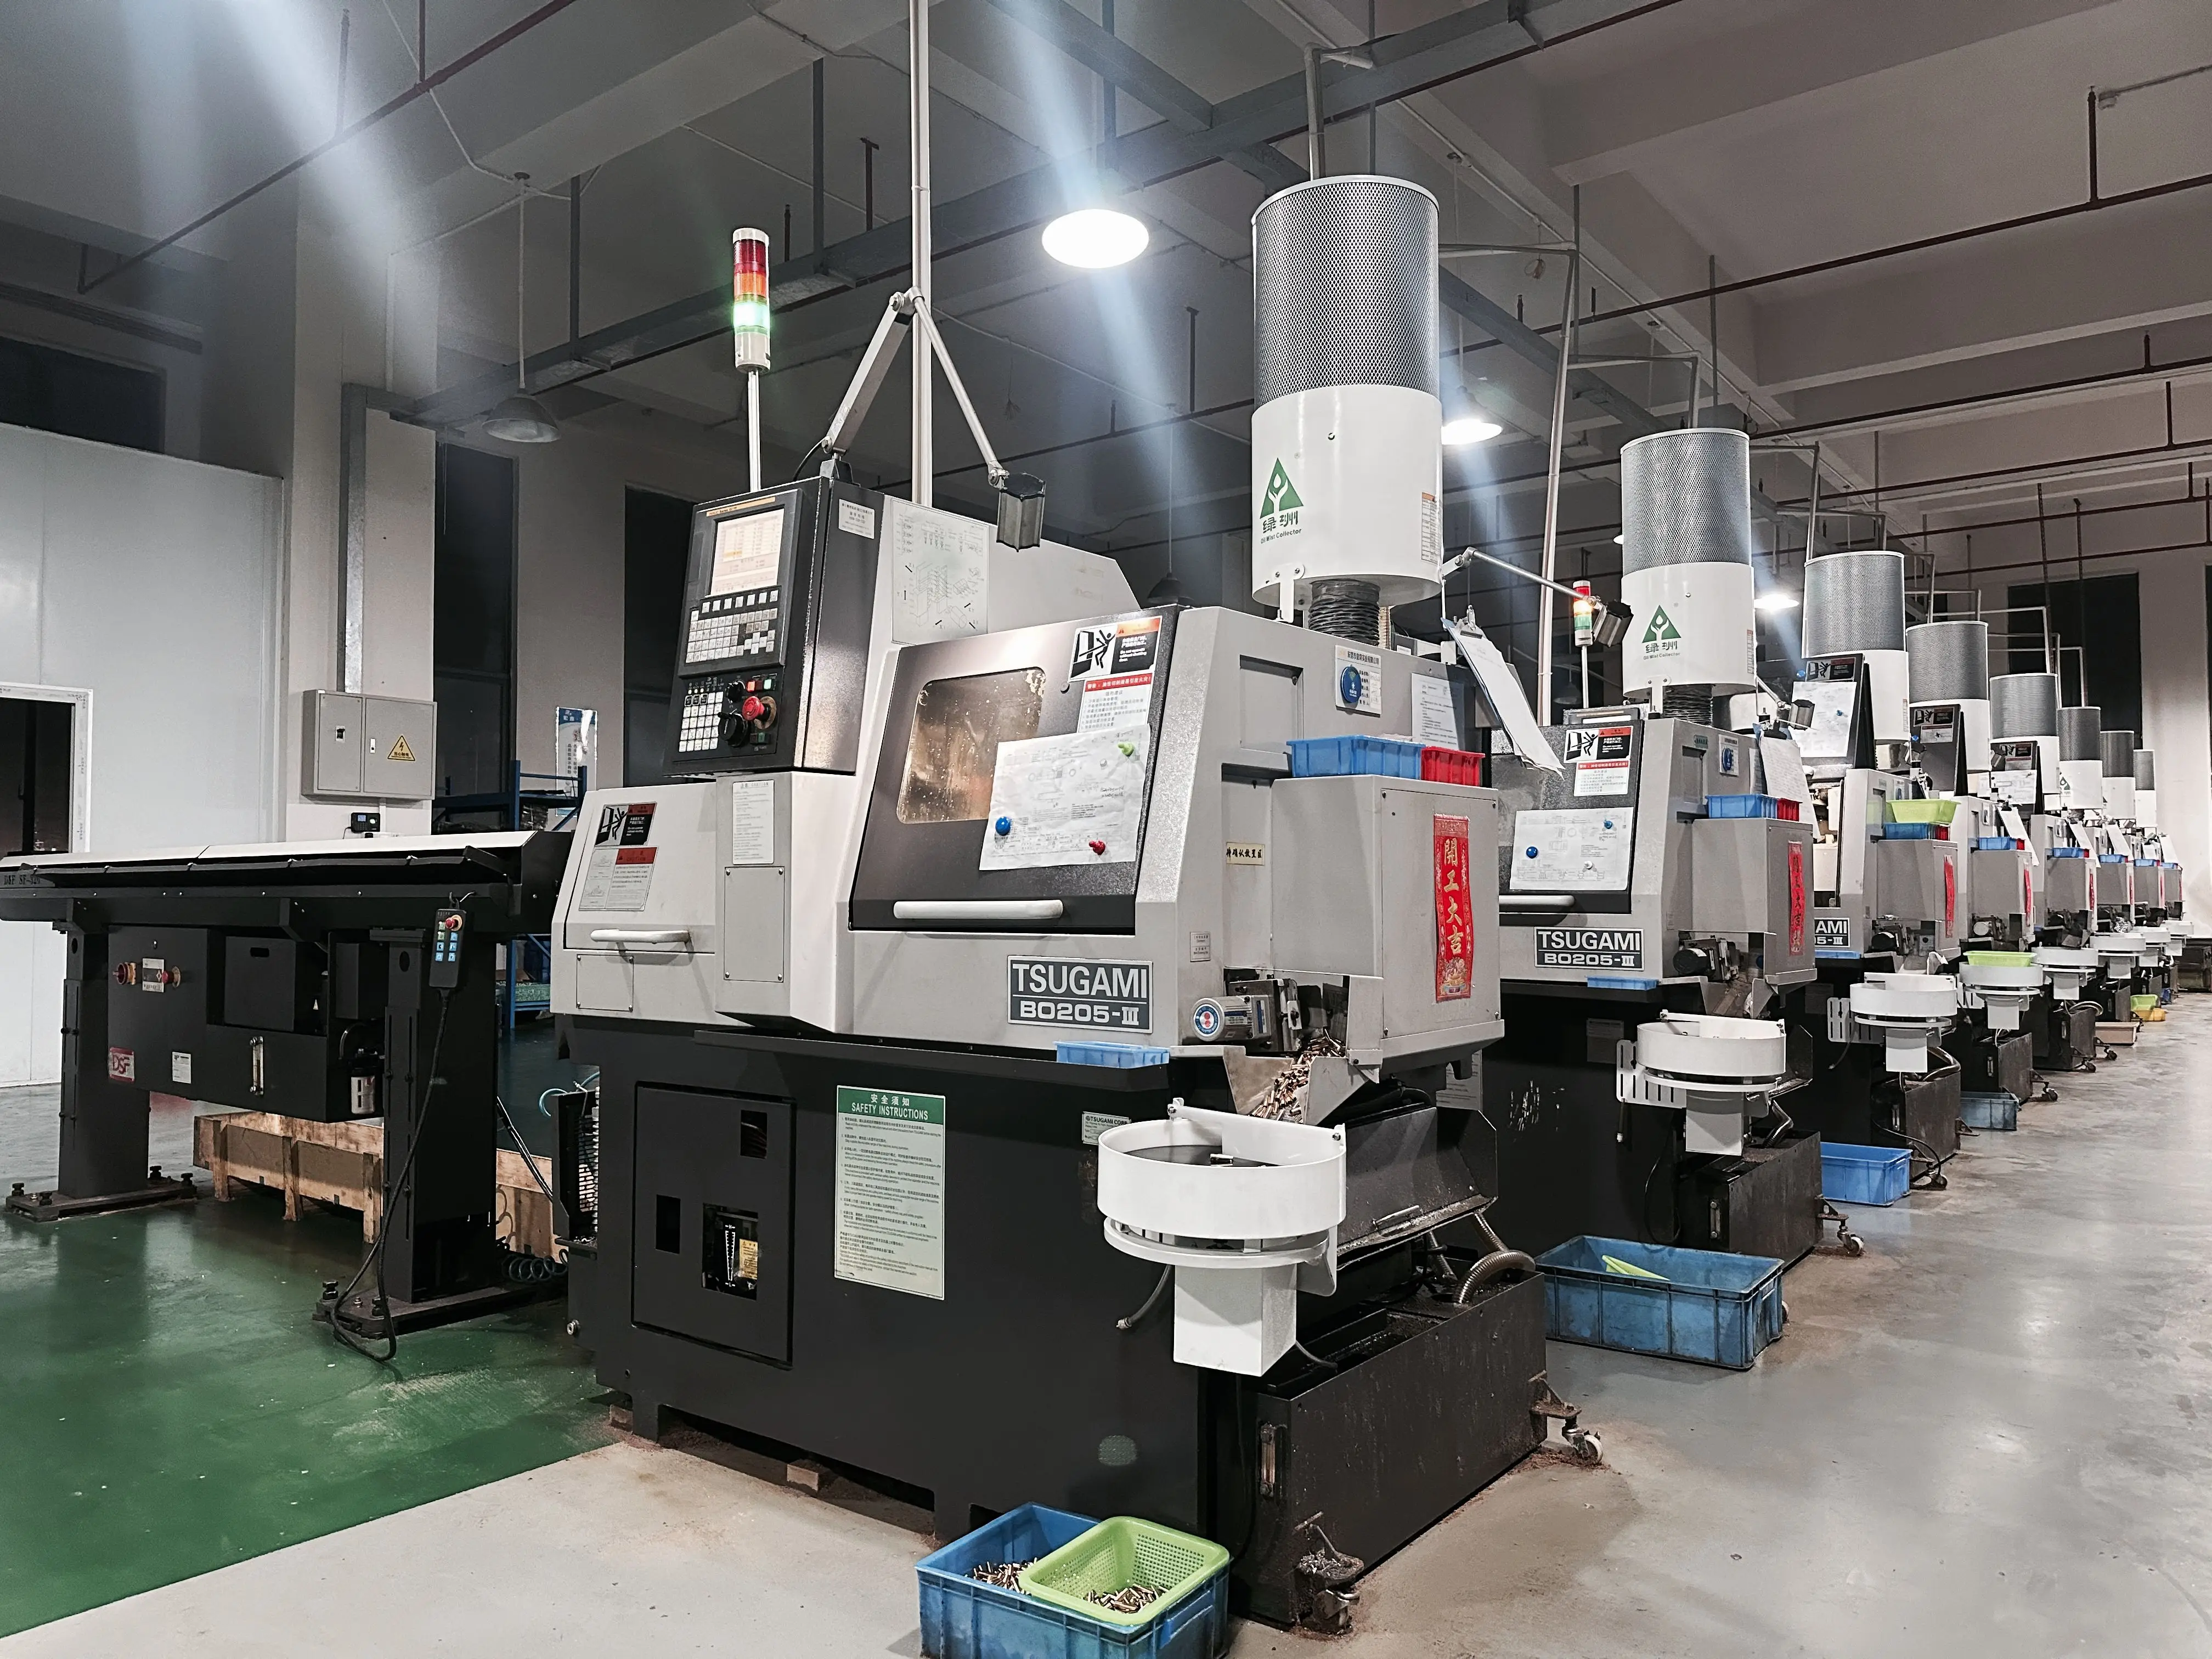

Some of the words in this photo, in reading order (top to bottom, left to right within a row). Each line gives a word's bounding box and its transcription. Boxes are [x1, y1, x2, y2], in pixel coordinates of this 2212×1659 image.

[1277, 529, 1302, 538] Collector
[1443, 837, 1463, 955] 開工大吉
[1538, 931, 1640, 951] TSUGAMI
[1012, 963, 1147, 998] TSUGAMI
[112, 1054, 131, 1074] DSF
[871, 1093, 910, 1107] 安全须知
[851, 1102, 877, 1114] SAFETY
[879, 1105, 928, 1120] INSTRUCTIONS
[1090, 1116, 1114, 1124] TSUGAMI
